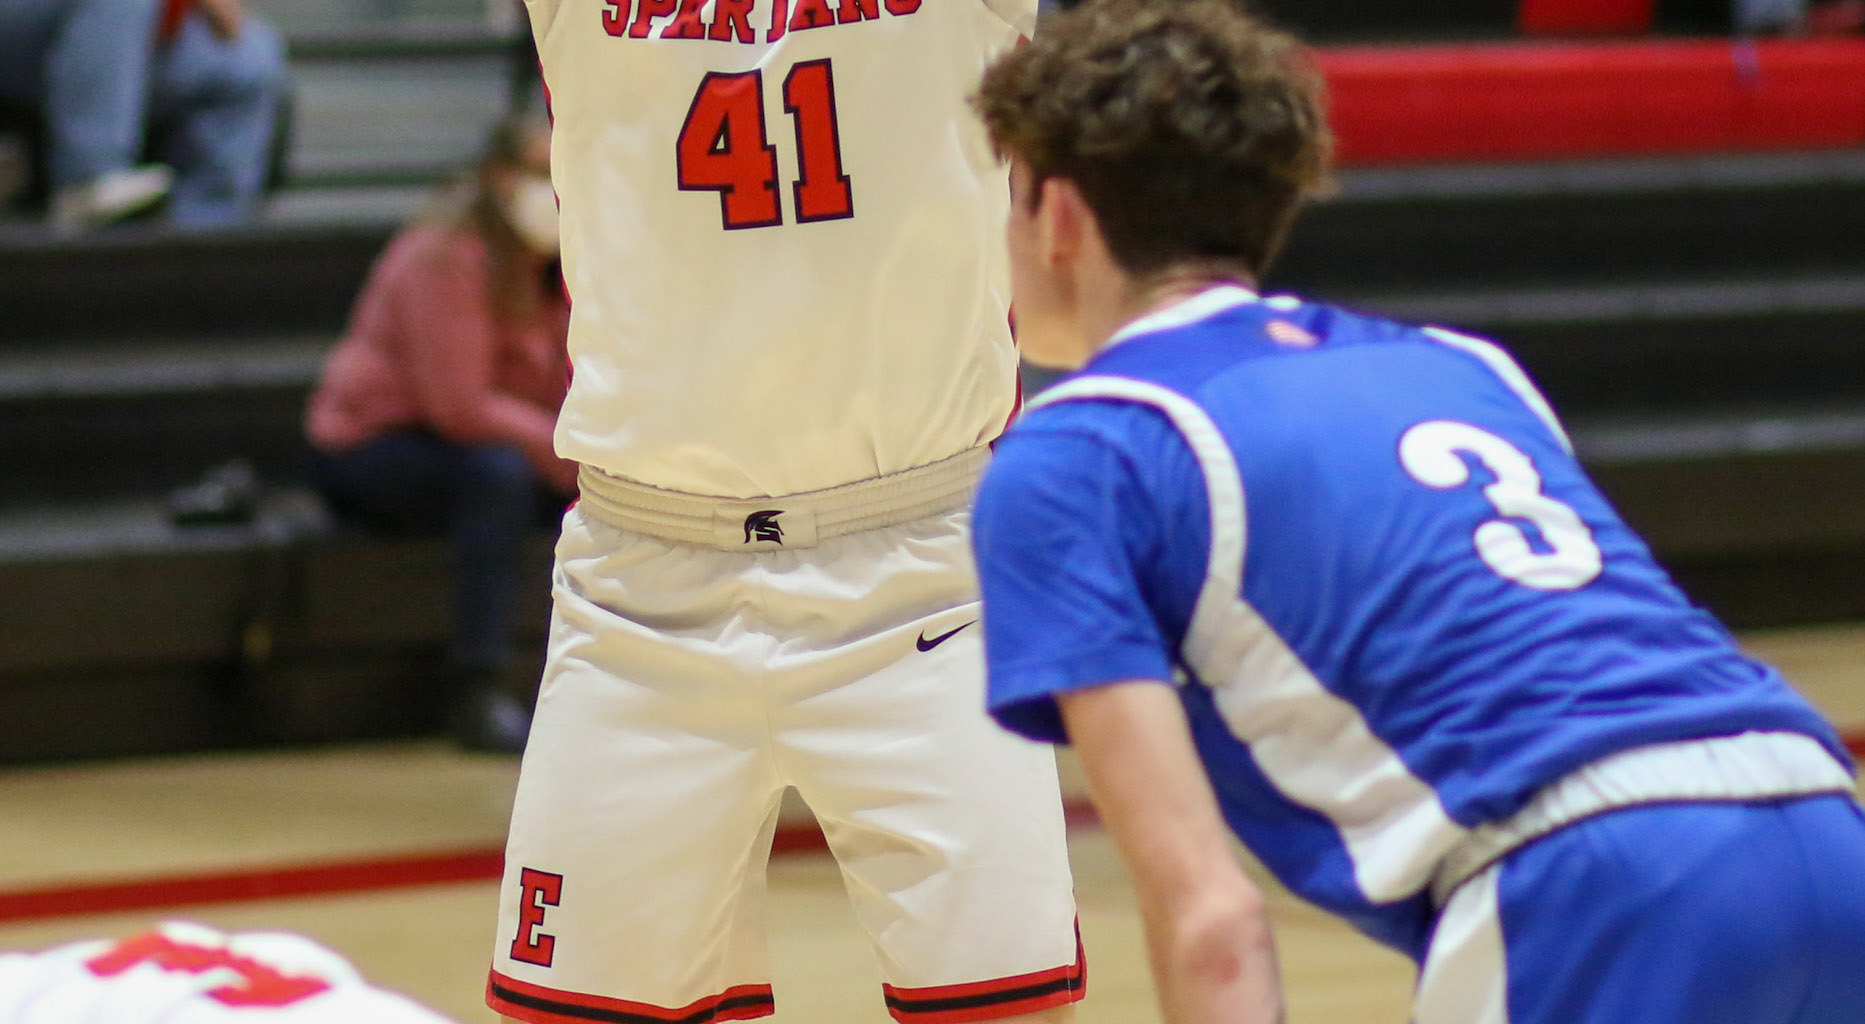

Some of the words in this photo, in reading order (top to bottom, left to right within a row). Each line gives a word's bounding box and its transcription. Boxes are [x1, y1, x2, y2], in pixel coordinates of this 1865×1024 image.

[676, 57, 854, 231] 41
[1399, 420, 1603, 590] 3
[509, 866, 564, 968] E
